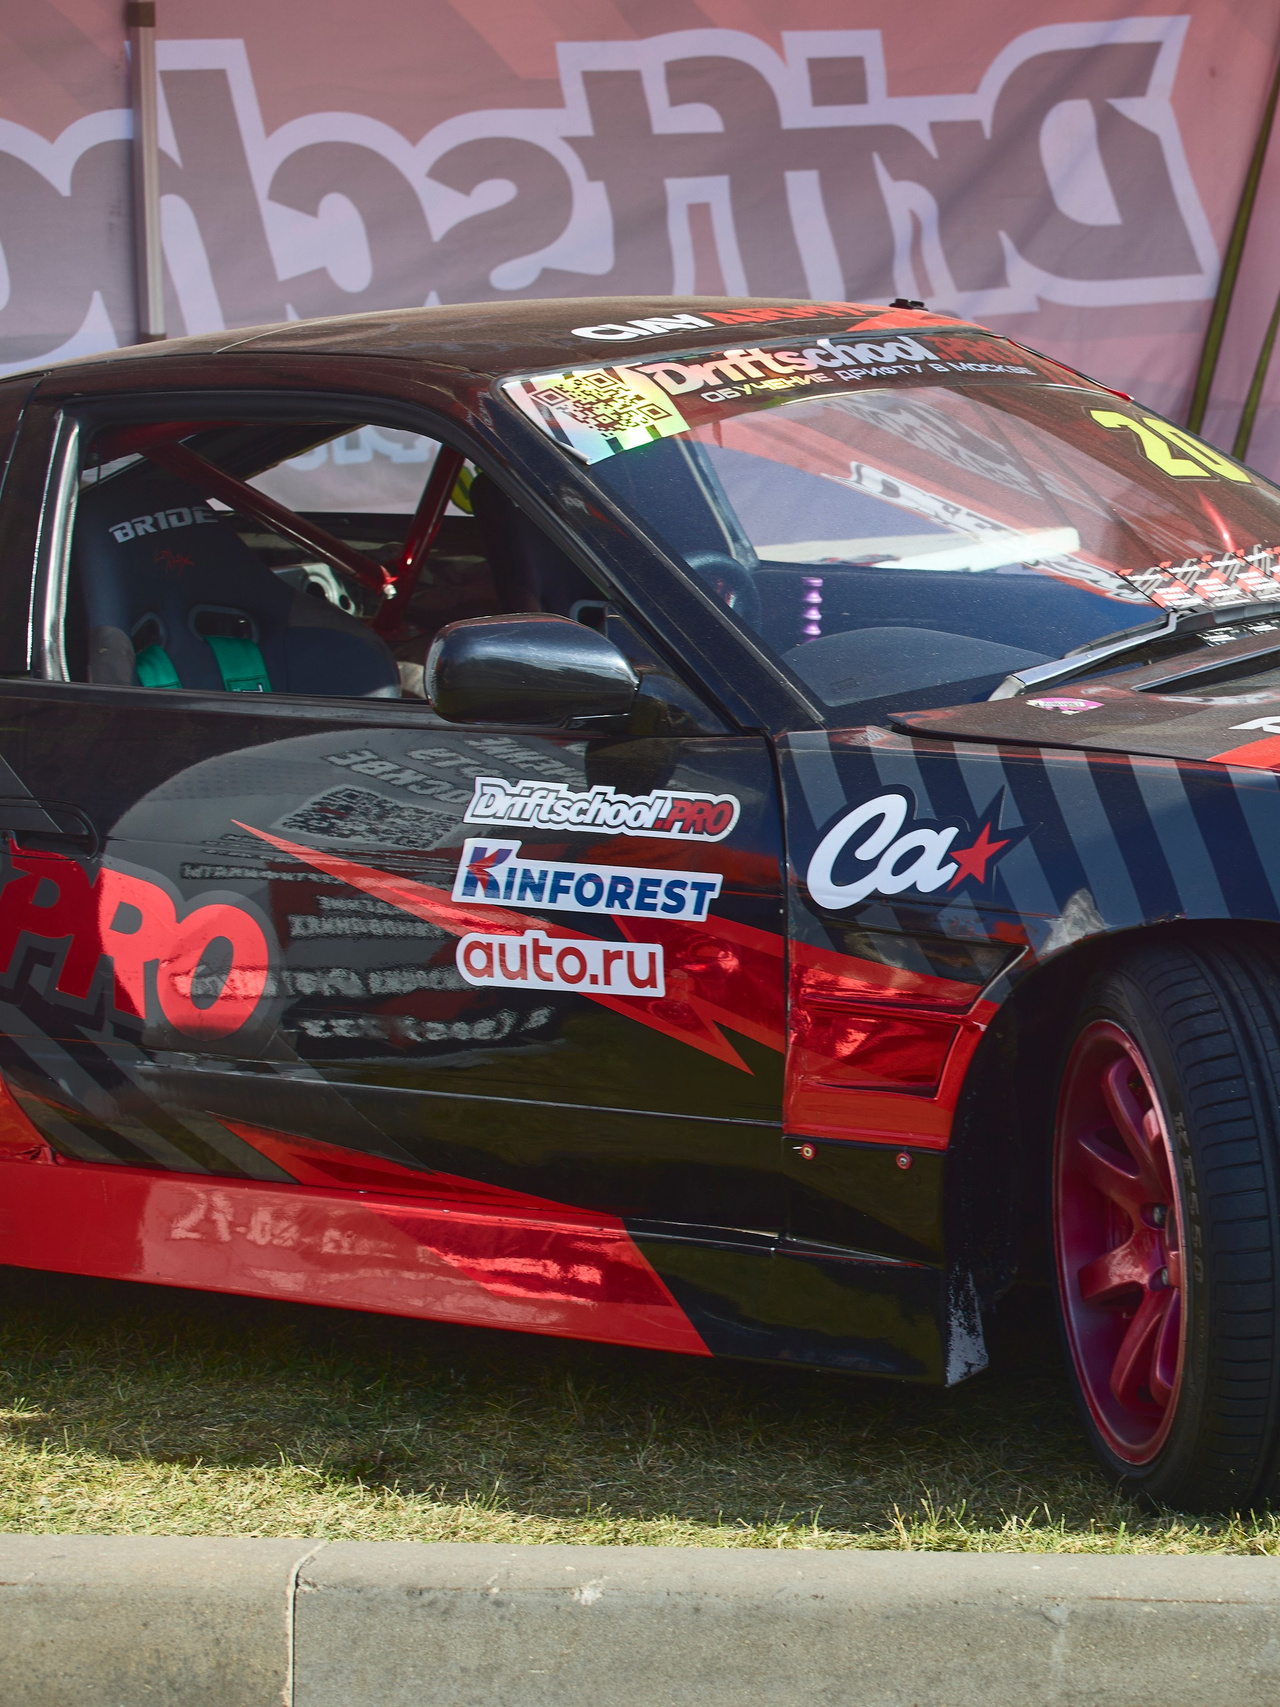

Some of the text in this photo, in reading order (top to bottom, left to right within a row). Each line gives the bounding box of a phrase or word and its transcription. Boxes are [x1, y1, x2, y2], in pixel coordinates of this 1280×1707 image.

[700, 361, 1038, 403] ОБУЧЕНИЕ ДРИФТУ В МОСКВЕ
[461, 846, 718, 916] KINFOREST
[463, 937, 658, 989] auto.ru
